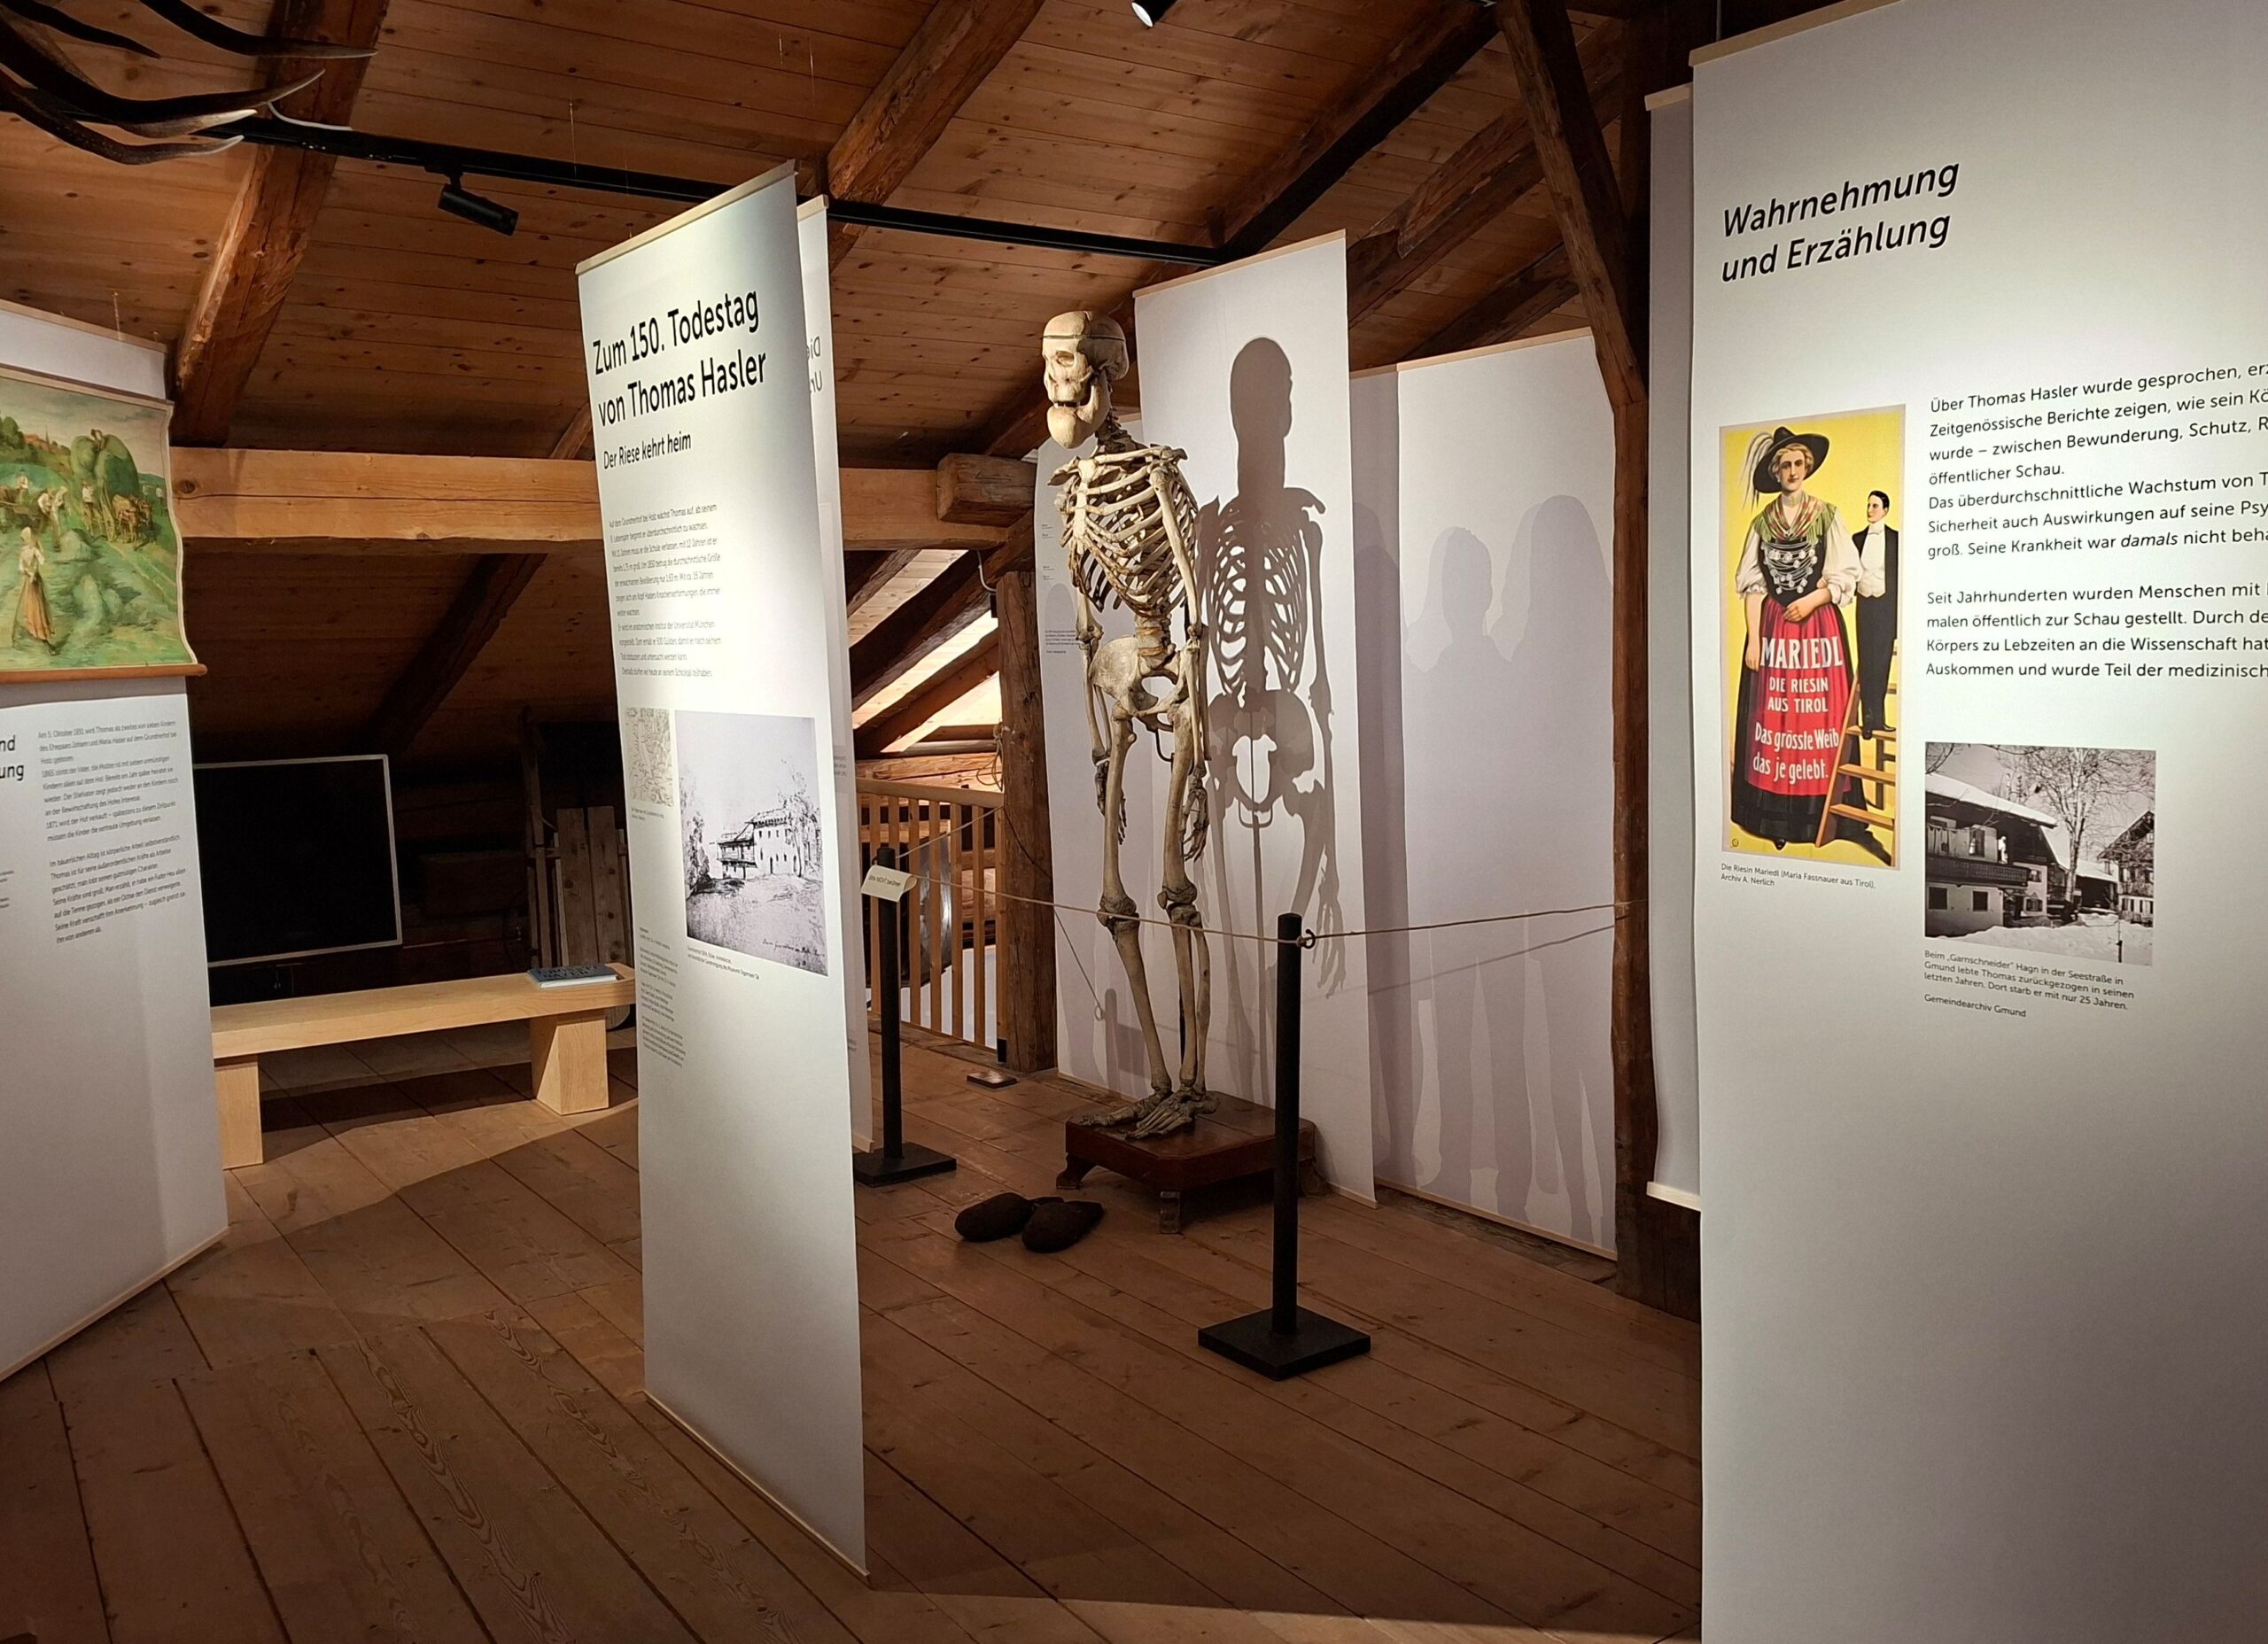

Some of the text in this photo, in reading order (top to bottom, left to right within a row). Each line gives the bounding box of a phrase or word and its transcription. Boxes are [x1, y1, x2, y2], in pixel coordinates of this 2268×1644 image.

[1723, 163, 1960, 237] Wahrnehmung
[1721, 214, 1950, 283] und Erzählung
[593, 291, 759, 375] Zum 150. Todestag
[598, 396, 625, 427] von
[627, 372, 695, 417] Thomas
[700, 349, 766, 397] Hasler
[1930, 397, 1964, 413] Über
[1968, 392, 2025, 408] Thomas
[2031, 384, 2078, 401] Hasler
[2083, 377, 2132, 395] wurde
[2138, 368, 2241, 392] gesprochen,
[1930, 415, 2042, 438] Zeitgenössische
[2047, 407, 2110, 424] Berichte
[2115, 402, 2171, 419] zeigen,
[2177, 396, 2205, 411] wie
[2210, 392, 2243, 408] sein
[603, 430, 691, 469] Der Riese kehrt heim
[1930, 446, 1973, 461] wurde
[1992, 438, 2062, 455] zwischen
[2067, 428, 2183, 448] Bewunderung,
[2189, 421, 2251, 437] Schutz,
[1929, 464, 2064, 485] öffentlicher Schau.
[1929, 497, 1953, 509] Das
[1958, 484, 2123, 508] überdurchschnittliche
[2128, 478, 2216, 494] Wachstum
[2221, 477, 2253, 488] von
[1929, 517, 1998, 533] Sicherheit
[2002, 515, 2038, 529] auch
[2043, 509, 2154, 525] Auswirkungen
[2159, 504, 2186, 519] auf
[2191, 503, 2234, 517] seine
[1928, 543, 1962, 560] groß.
[1968, 542, 2007, 555] Seine
[2011, 537, 2082, 553] Krankheit
[2087, 539, 2117, 549] war
[2121, 531, 2179, 547] damals
[2184, 530, 2226, 545] nicht
[1927, 582, 2260, 604] Seit Jahrhunderten wurden Menschen mit
[1927, 616, 1968, 628] malen
[1972, 614, 2041, 627] öffentlich
[2046, 616, 2070, 626] zur
[2074, 612, 2120, 625] Schau
[2124, 611, 2186, 628] gestellt.
[2194, 609, 2244, 624] Durch
[1760, 636, 1844, 669] MARIEDL
[1927, 640, 1979, 655] Körpers
[1983, 642, 2000, 651] zu
[2004, 638, 2075, 651] Lebzeiten
[2079, 640, 2097, 651] an
[2102, 638, 2125, 651] die
[2131, 637, 2238, 651] Wissenschaft
[1769, 677, 1829, 694] DIE RIESIN
[1926, 663, 2268, 678] Auskommen und wurde Teil der medizinisch
[1767, 697, 1829, 713] AUS TIROL
[1754, 722, 1839, 752] Das grösste Weib
[1752, 752, 1829, 784] das je gelebt.
[1720, 872, 1742, 882] Archiv
[1751, 877, 1775, 886] Nerlich
[1721, 863, 1732, 872] Die
[1734, 865, 1753, 873] Riesin
[1754, 867, 1779, 877] Mariedl
[1781, 870, 1802, 880] (Maria
[1924, 950, 1946, 960] Beim
[2016, 963, 2039, 974] Hagn
[2040, 966, 2049, 975] in
[2051, 968, 2066, 977] der
[2068, 970, 2113, 984] Seestraße
[1924, 961, 2134, 999] Gmund lebte Thomas zurückgezogen in seinen
[1924, 972, 1953, 983] letzten
[1954, 976, 1985, 989] Jahren.
[1988, 981, 2008, 992] Dort
[2009, 986, 2031, 996] starb
[2045, 991, 2060, 1000] mit
[2079, 995, 2091, 1004] 25
[2093, 997, 2128, 1010] Jahren.
[1924, 994, 2026, 1018] Gemeindearchiv Gmund
